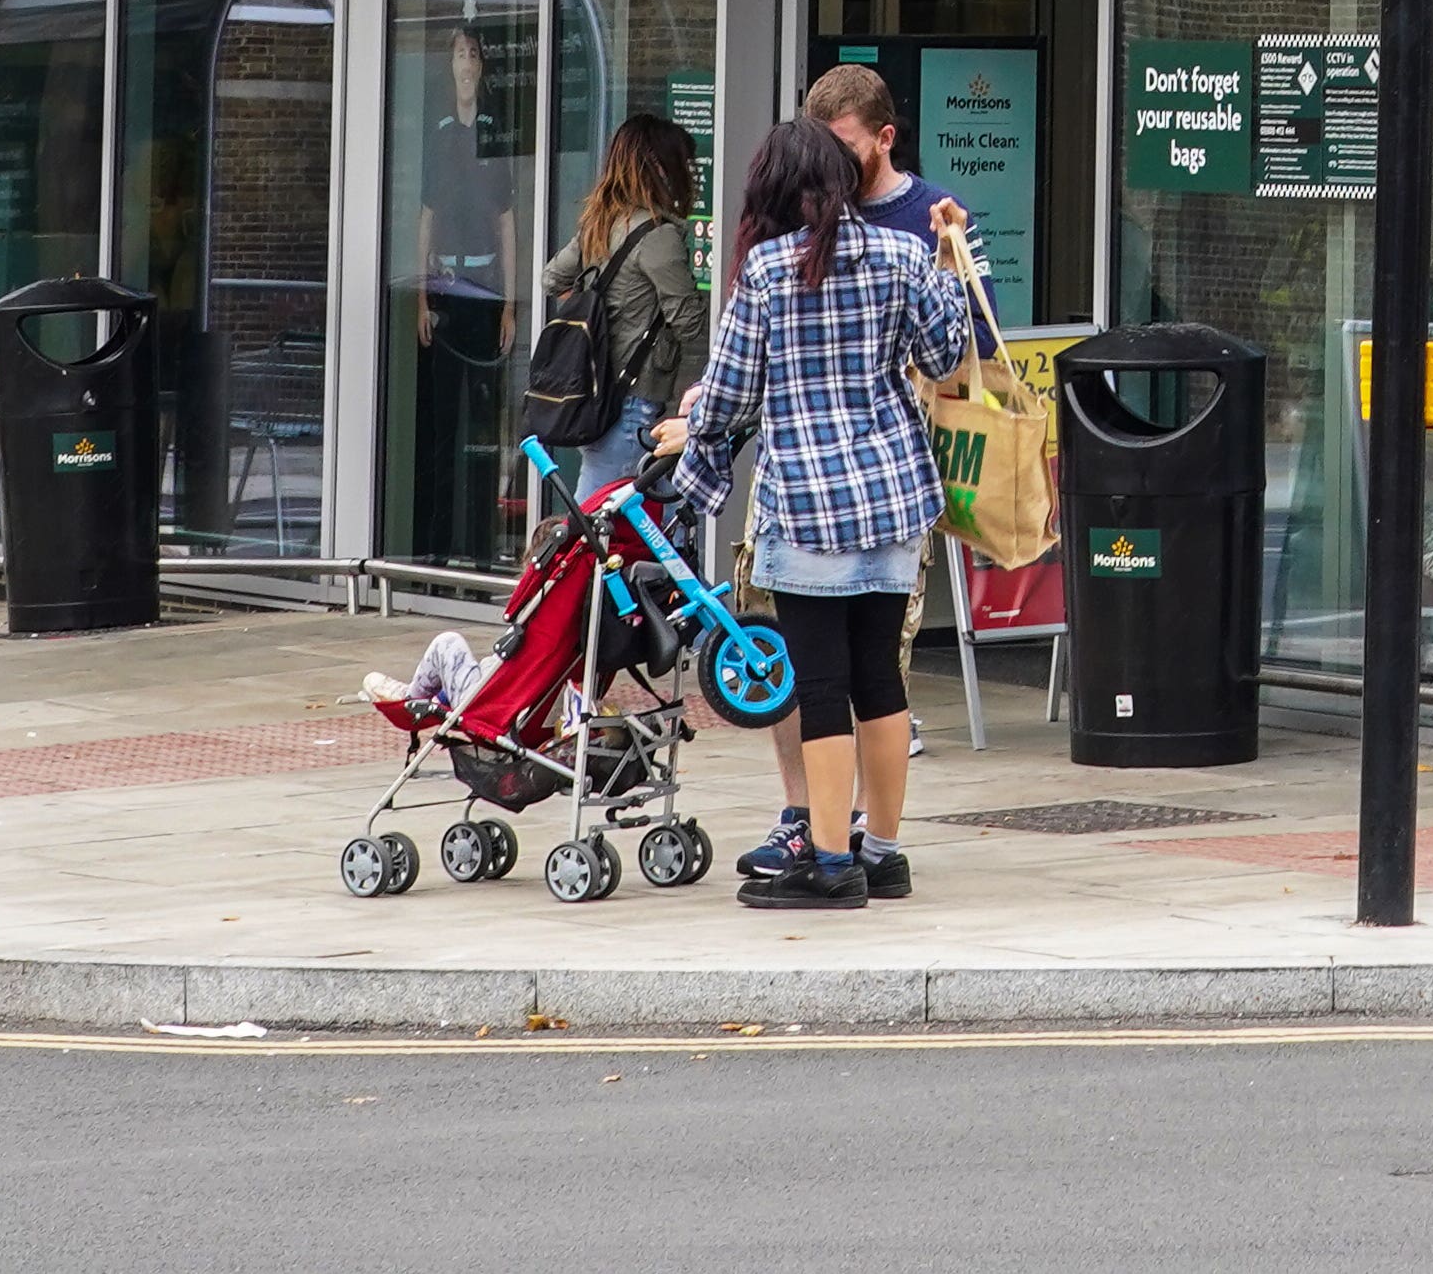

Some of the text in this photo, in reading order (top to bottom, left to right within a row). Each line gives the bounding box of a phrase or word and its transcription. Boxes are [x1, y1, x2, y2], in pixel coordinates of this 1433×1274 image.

[1277, 52, 1303, 65] Reward
[1326, 52, 1355, 64] CCTV in
[1326, 66, 1360, 80] operation
[1145, 67, 1188, 92] Don't
[1191, 65, 1241, 101] forget
[946, 94, 1012, 110] Morrisons
[1135, 103, 1242, 136] your reusable
[937, 132, 1020, 149] Think Clean:
[1170, 138, 1206, 175] bags
[950, 157, 1006, 177] Hygiene
[1035, 352, 1047, 373] 2
[57, 452, 112, 465] Morrisons
[1093, 552, 1156, 568] Morrisons
